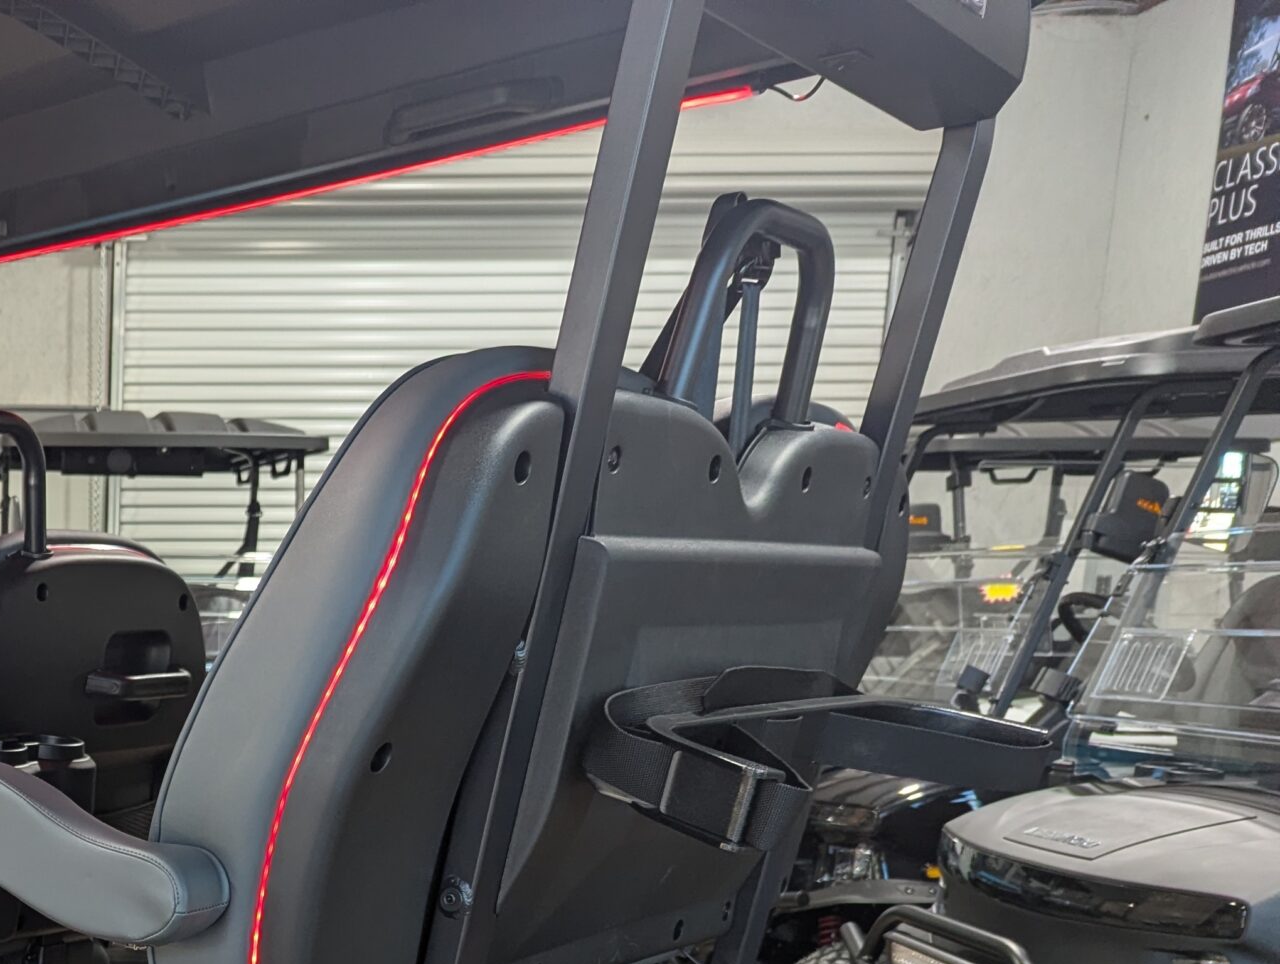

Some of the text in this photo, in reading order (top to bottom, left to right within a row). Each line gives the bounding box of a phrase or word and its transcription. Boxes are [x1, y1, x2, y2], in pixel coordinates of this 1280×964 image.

[1207, 184, 1258, 227] PLUS
[1224, 232, 1243, 247] FOR
[1229, 245, 1242, 260] BY
[1243, 240, 1268, 256] TECH
